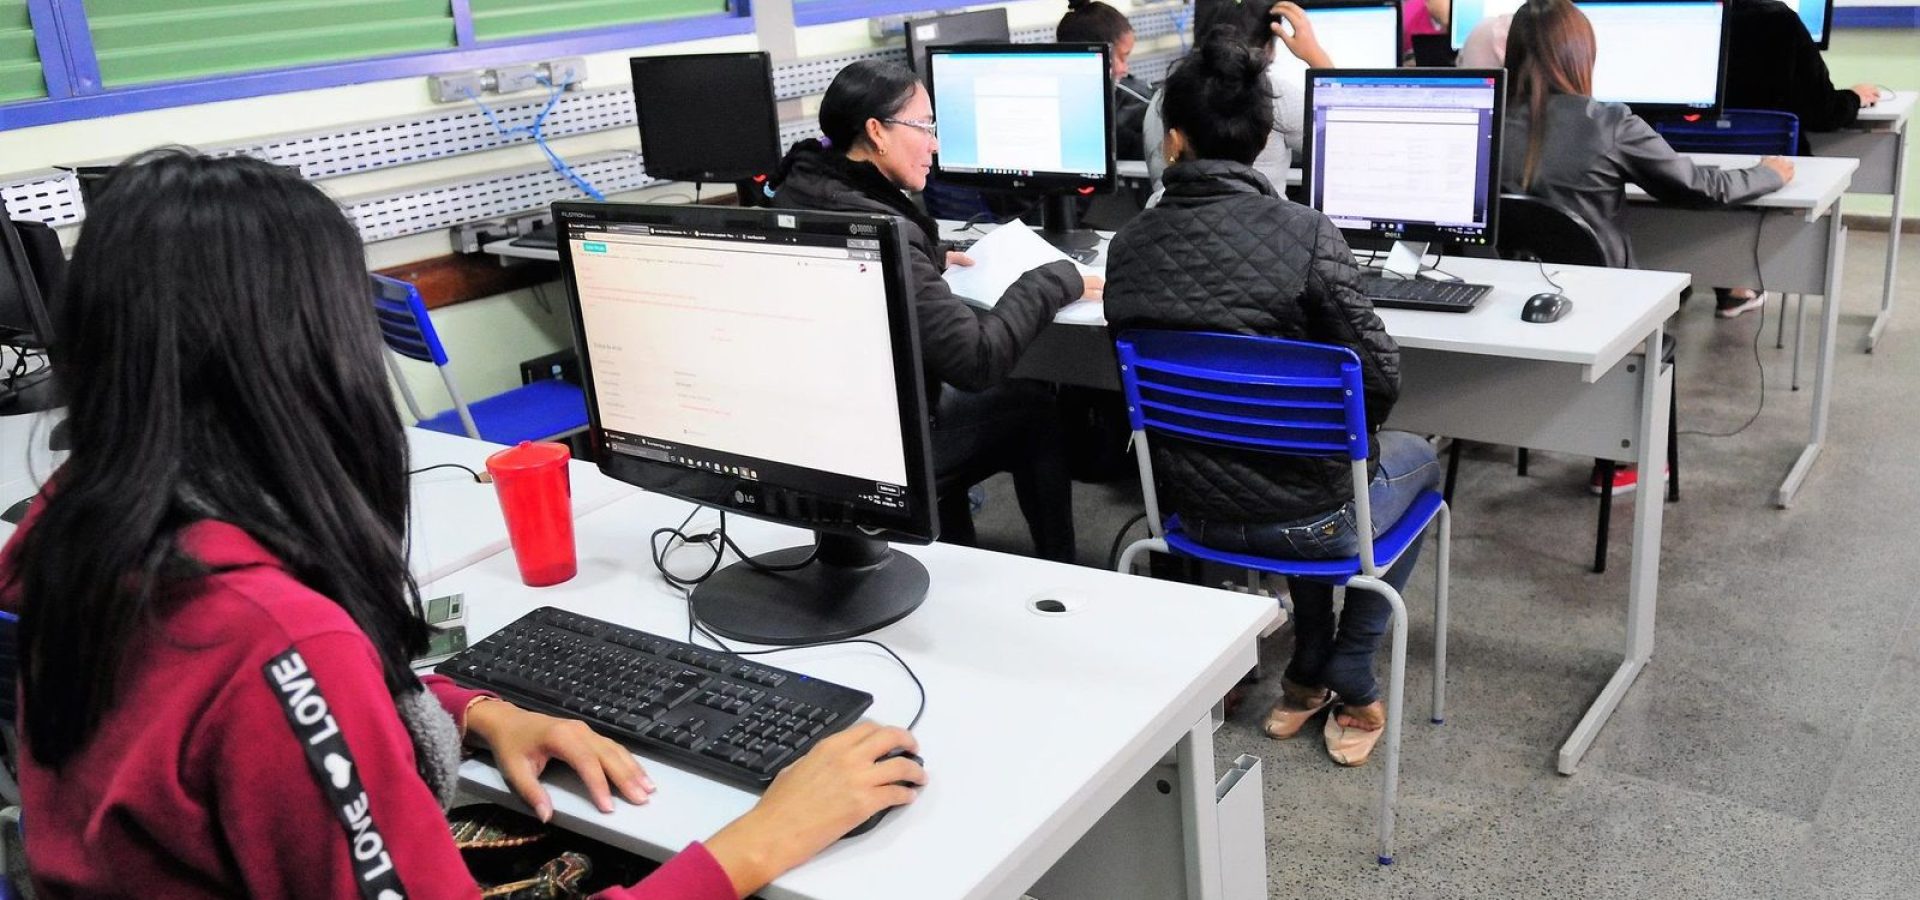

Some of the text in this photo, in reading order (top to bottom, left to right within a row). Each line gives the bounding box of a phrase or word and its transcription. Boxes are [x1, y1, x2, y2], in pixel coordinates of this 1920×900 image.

[1384, 231, 1402, 239] DELL
[271, 652, 339, 745] LOVE
[343, 791, 393, 882] LOVE
